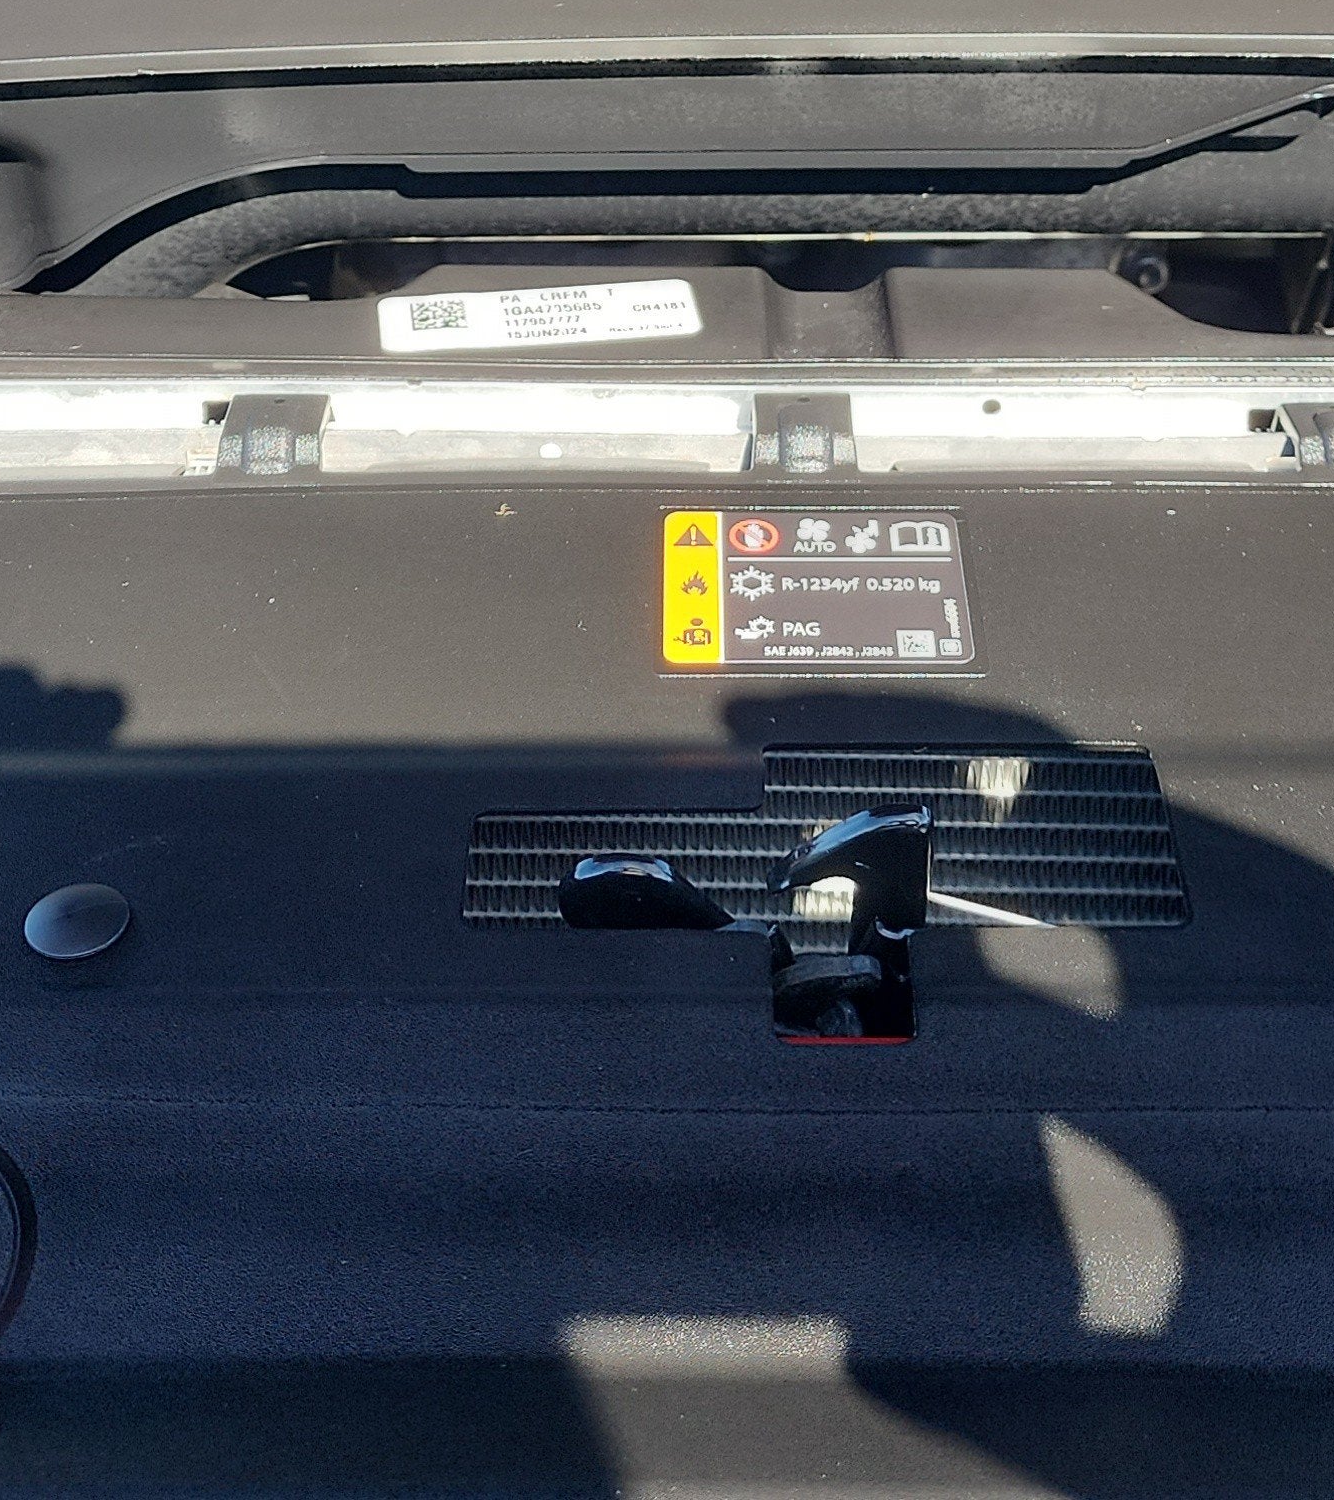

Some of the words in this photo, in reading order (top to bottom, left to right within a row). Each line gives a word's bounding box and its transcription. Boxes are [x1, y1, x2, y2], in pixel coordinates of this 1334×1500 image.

[793, 541, 837, 553] AUTO
[781, 577, 860, 592] R-1234yf
[866, 577, 916, 592] 0.520
[918, 577, 942, 594] kg
[782, 622, 821, 637] PAG
[764, 646, 786, 657] SAE
